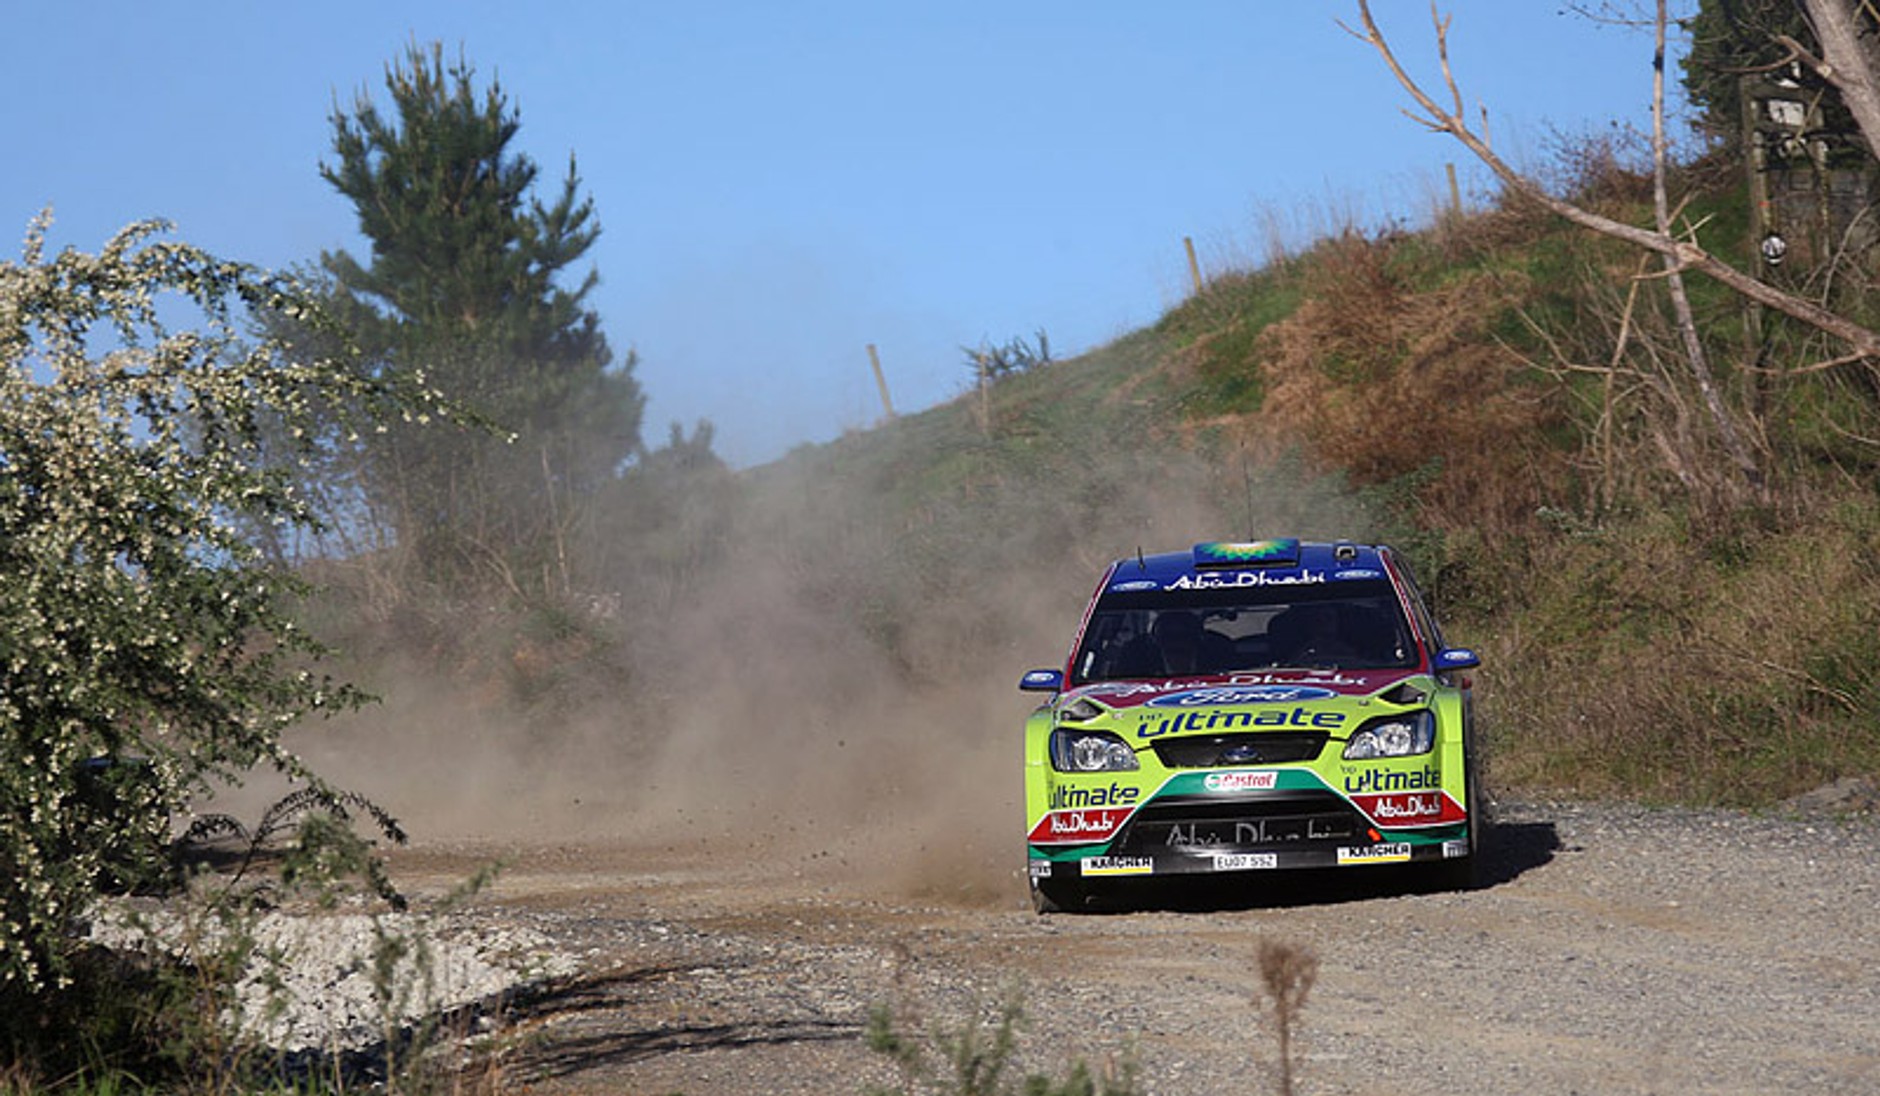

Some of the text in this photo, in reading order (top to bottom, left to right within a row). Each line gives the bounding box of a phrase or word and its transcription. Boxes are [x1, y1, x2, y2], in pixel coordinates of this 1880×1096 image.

[1230, 569, 1326, 588] Dhabi
[1137, 708, 1346, 737] ultimate
[1222, 773, 1273, 787] Castrol
[1344, 765, 1440, 792] ultimate
